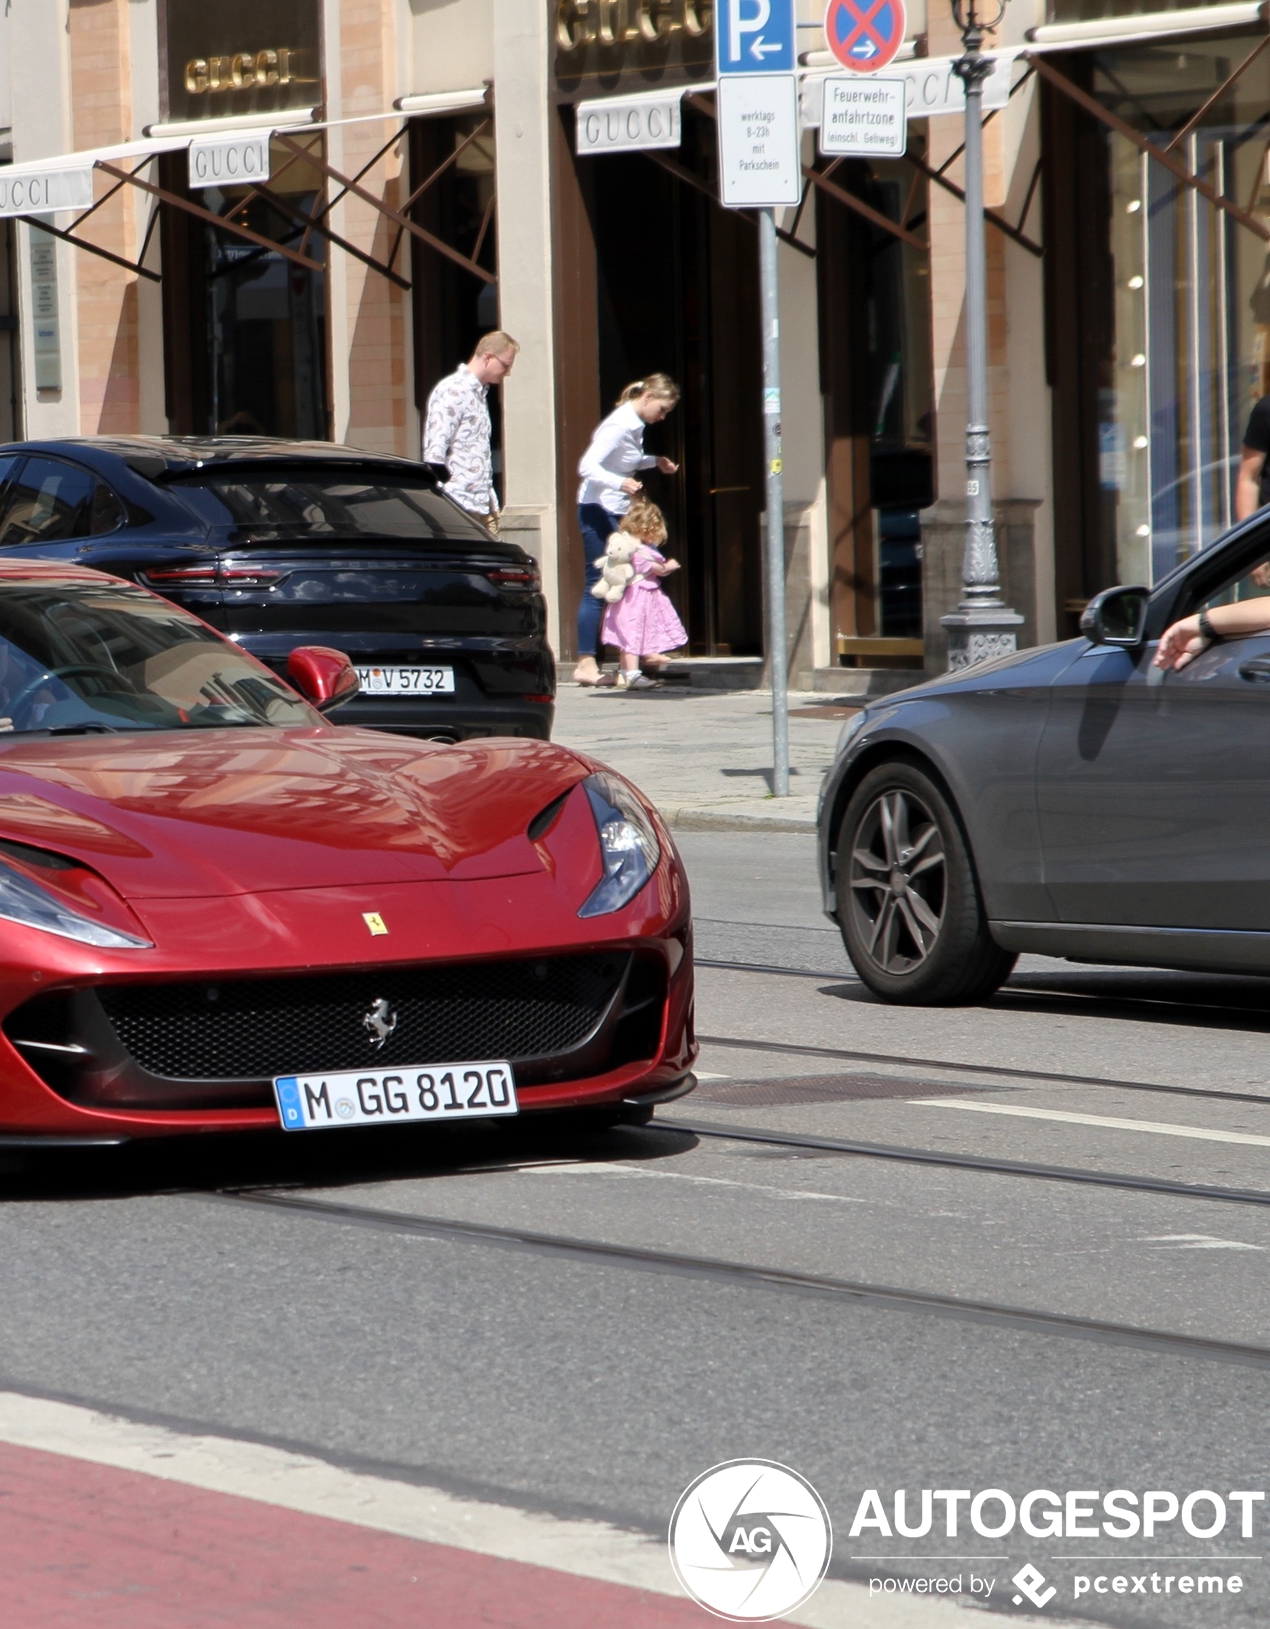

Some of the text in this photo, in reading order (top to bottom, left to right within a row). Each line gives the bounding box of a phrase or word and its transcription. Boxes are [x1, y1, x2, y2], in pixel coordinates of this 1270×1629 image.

[731, 0, 771, 61] P
[185, 49, 290, 93] GUCCI
[833, 87, 896, 104] Feuerwehr-
[585, 107, 674, 144] GUCCI
[740, 111, 775, 123] werktags
[831, 110, 895, 125] anfahrtzone
[746, 127, 771, 138] 8-23h
[752, 143, 765, 154] mit
[195, 145, 265, 179] GUCCI
[739, 159, 780, 171] Parkschein
[358, 668, 446, 689] M V 5732
[287, 1069, 511, 1121] D M GG 8120
